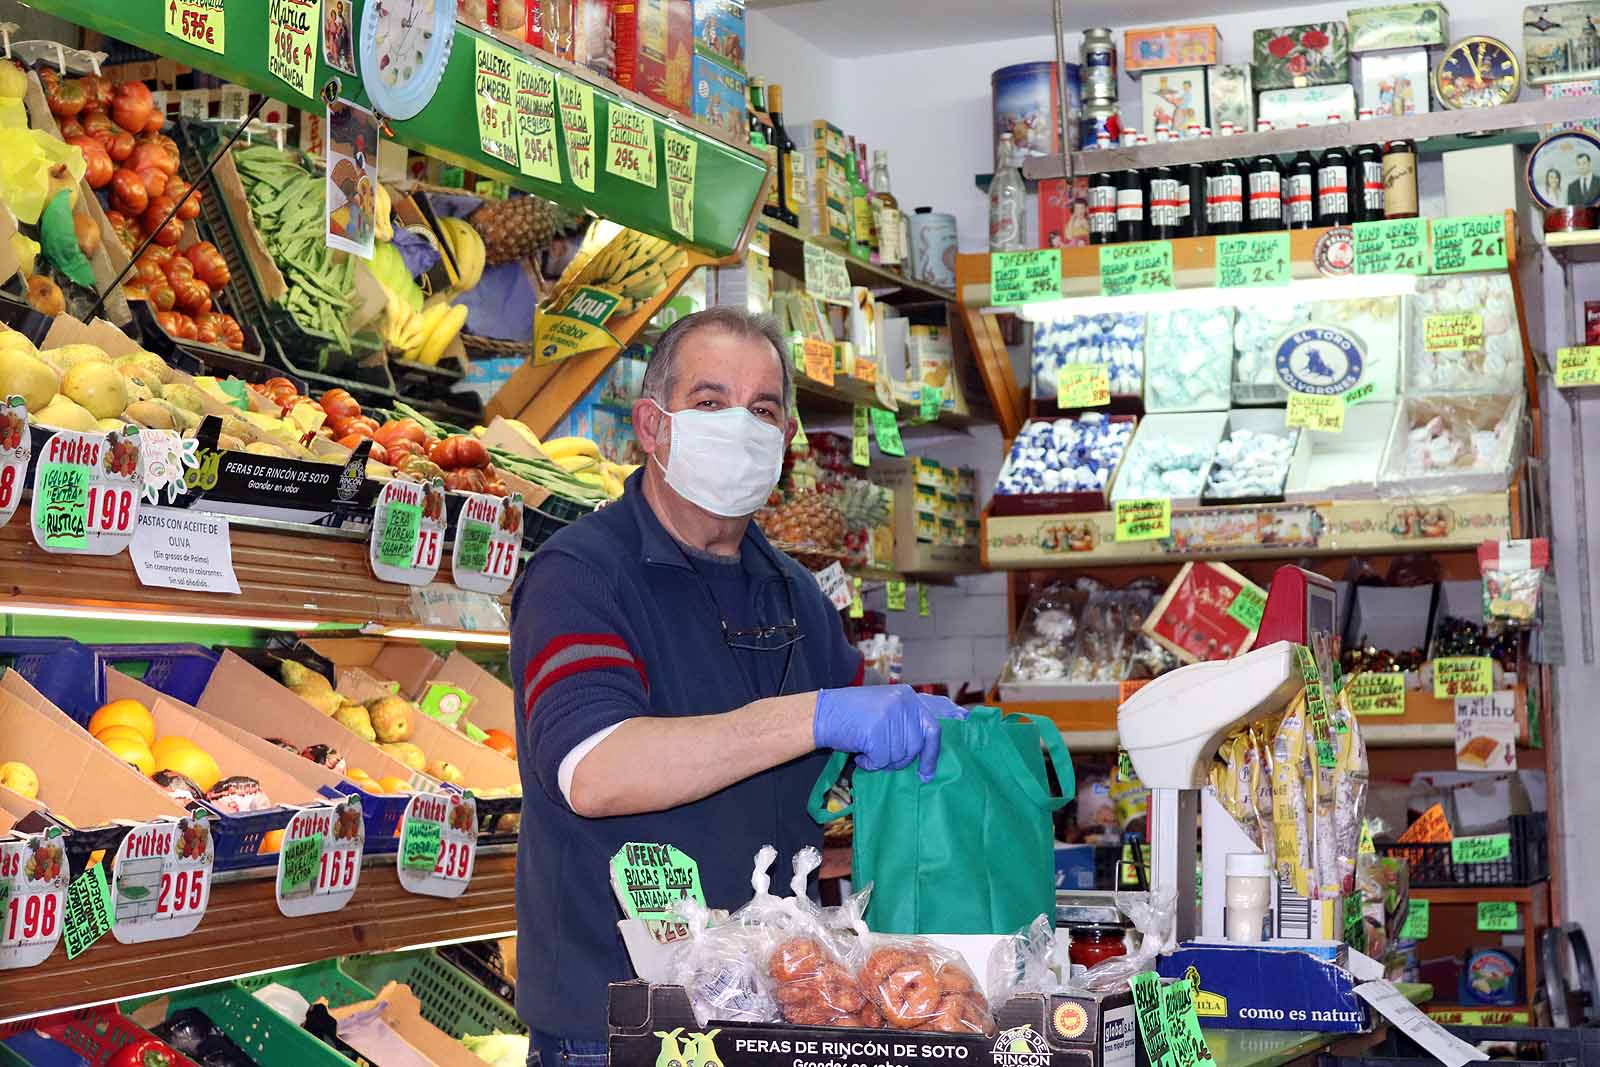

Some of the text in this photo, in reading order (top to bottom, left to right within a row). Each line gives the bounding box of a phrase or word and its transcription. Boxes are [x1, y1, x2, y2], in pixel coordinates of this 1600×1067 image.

[477, 50, 511, 77] GALLETAS
[477, 75, 512, 105] CAMPERA
[516, 70, 552, 94] NEVADITOS
[1294, 331, 1351, 350] EL TORO
[1280, 367, 1356, 394] POLVORONES
[49, 436, 99, 466] Frutas
[225, 462, 330, 484] PERAS DE RINCÓN DE SOTO
[248, 480, 274, 490] Grandes
[274, 484, 282, 492] en
[467, 496, 497, 523] Frutas
[46, 513, 84, 534] RUSTICA
[138, 515, 219, 535] PASTAS CON ACEITE DE
[168, 536, 191, 549] OLIVA
[183, 554, 190, 562] de
[412, 796, 447, 822] Frutas
[292, 812, 330, 839] Frutas
[126, 828, 171, 858] Frutas
[434, 839, 469, 878] 239
[625, 844, 673, 867] OFERTA
[320, 851, 356, 888] 165
[623, 866, 693, 886] BOLSAS PASTAS
[156, 870, 204, 913] 295
[9, 893, 57, 940] 198
[1239, 1007, 1284, 1020] como
[1289, 1009, 1306, 1021] es
[997, 1029, 1047, 1053] PERAS DE
[1105, 1020, 1124, 1041] global
[735, 1039, 969, 1059] PERAS DE RINCÓN DE SOTO
